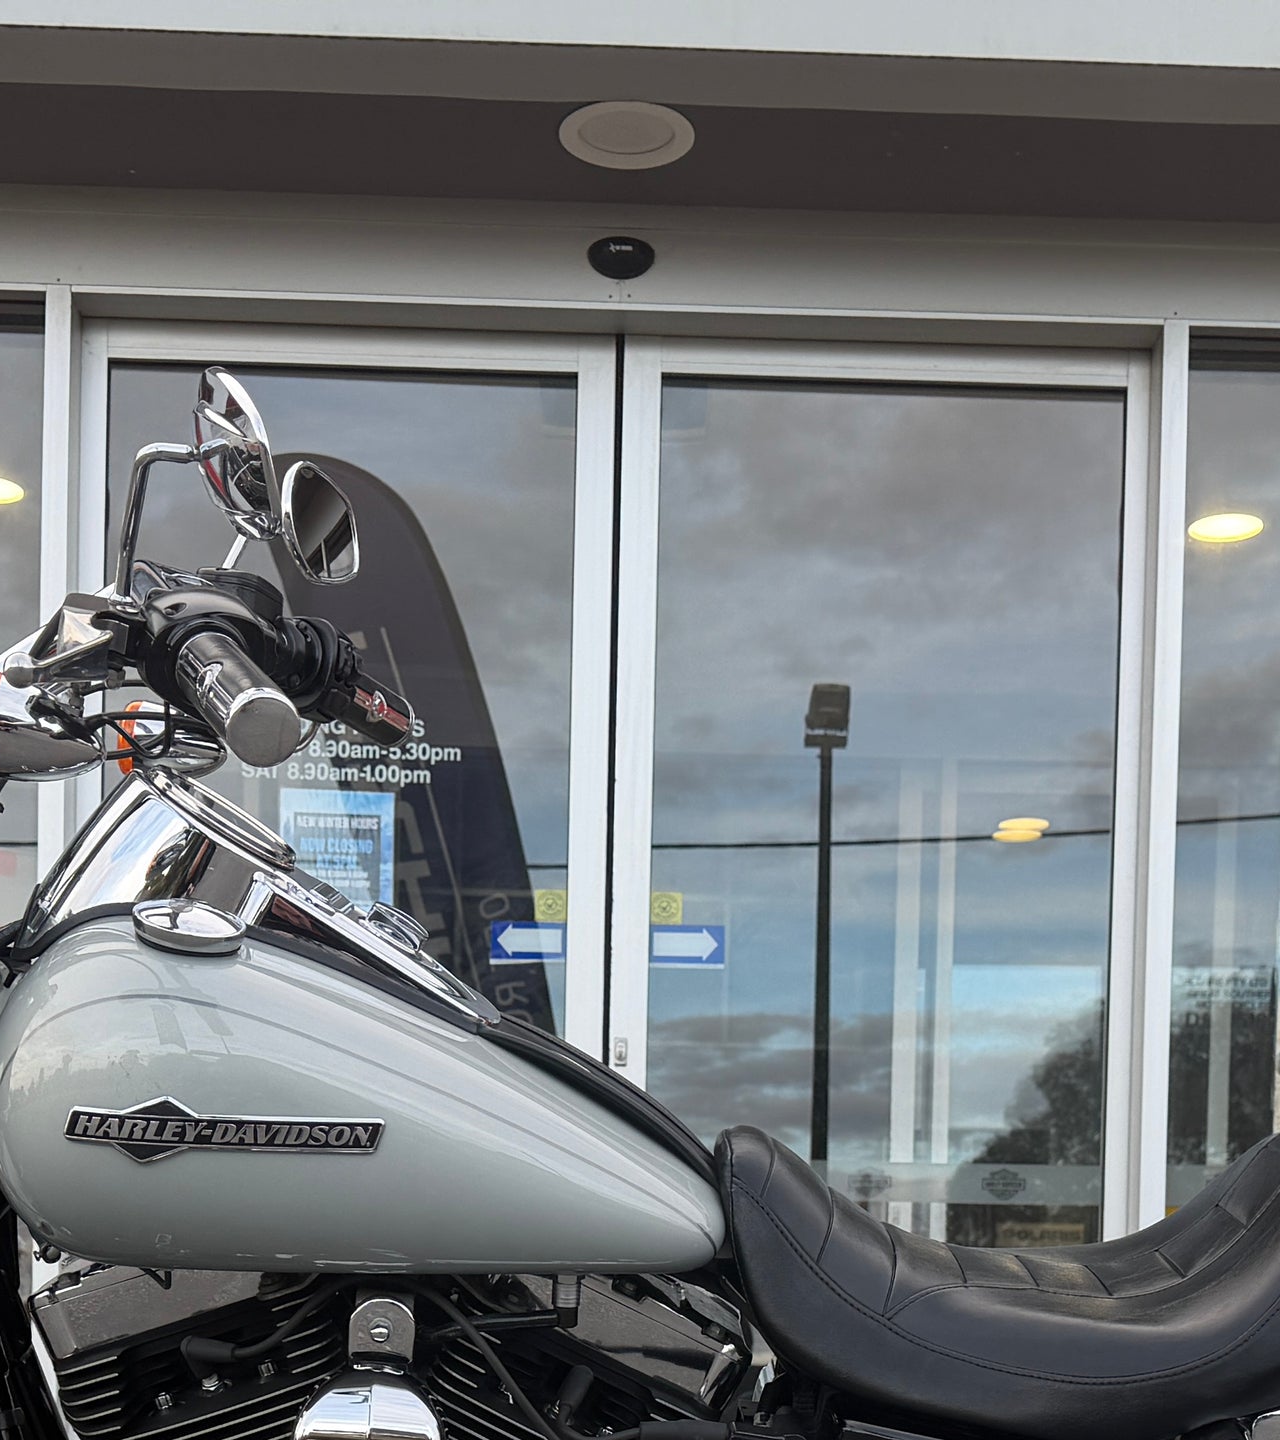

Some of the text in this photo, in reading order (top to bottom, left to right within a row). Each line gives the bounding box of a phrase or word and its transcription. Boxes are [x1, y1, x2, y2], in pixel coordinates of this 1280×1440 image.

[241, 764, 280, 779] SAT
[351, 817, 380, 830] HOURS
[326, 838, 374, 855] CLOSING
[73, 1114, 373, 1147] HARLEY-DAVIDSON
